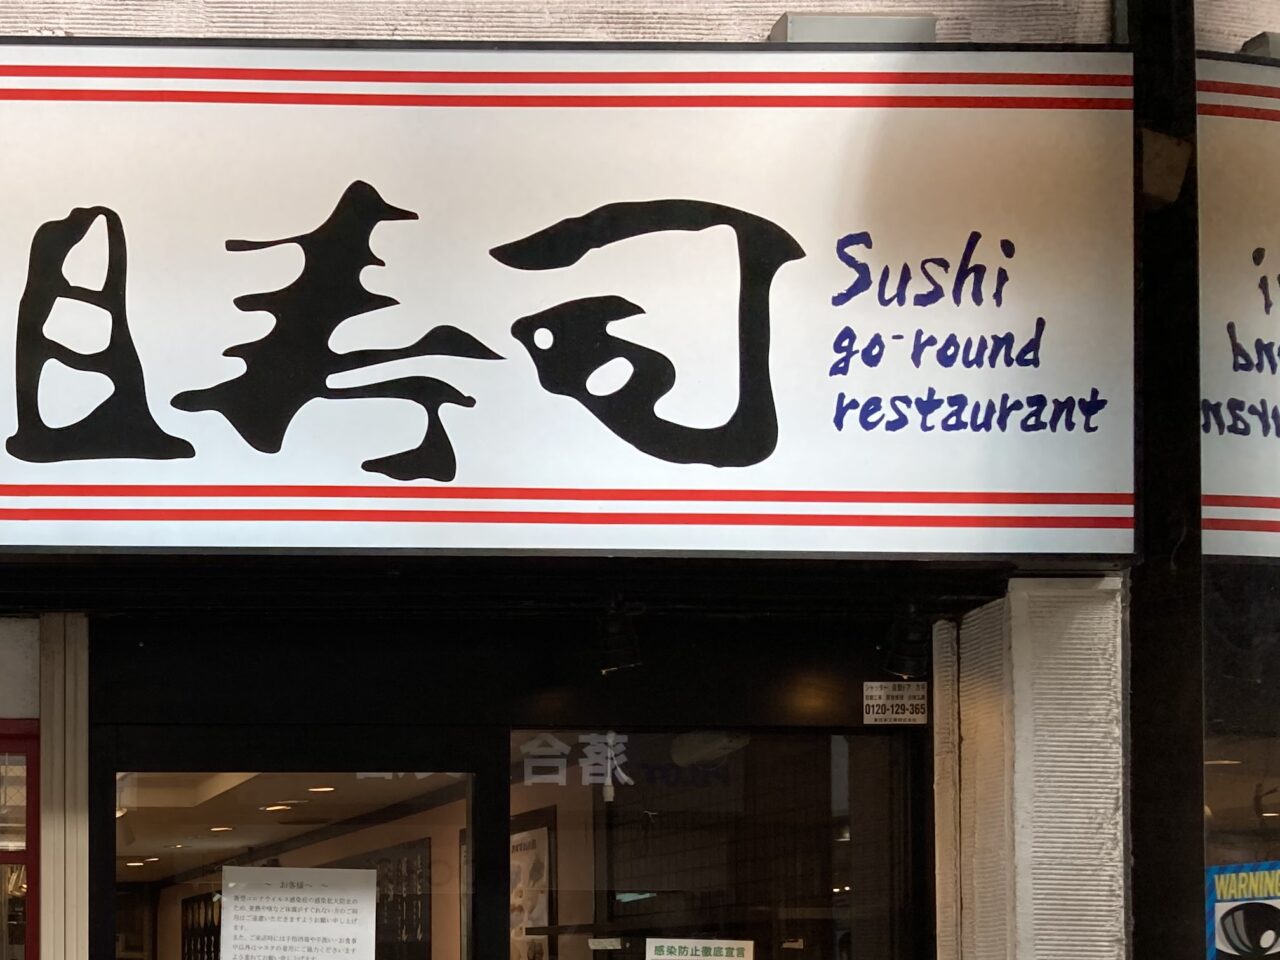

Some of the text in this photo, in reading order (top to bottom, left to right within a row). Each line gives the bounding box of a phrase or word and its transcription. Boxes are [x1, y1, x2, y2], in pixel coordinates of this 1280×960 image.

[831, 230, 1016, 308] Sushi
[828, 316, 1047, 377] go-round
[832, 386, 1108, 434] restaurant
[864, 703, 926, 715] 0120-129-365
[654, 945, 747, 958] 感染防止徹底宣言
